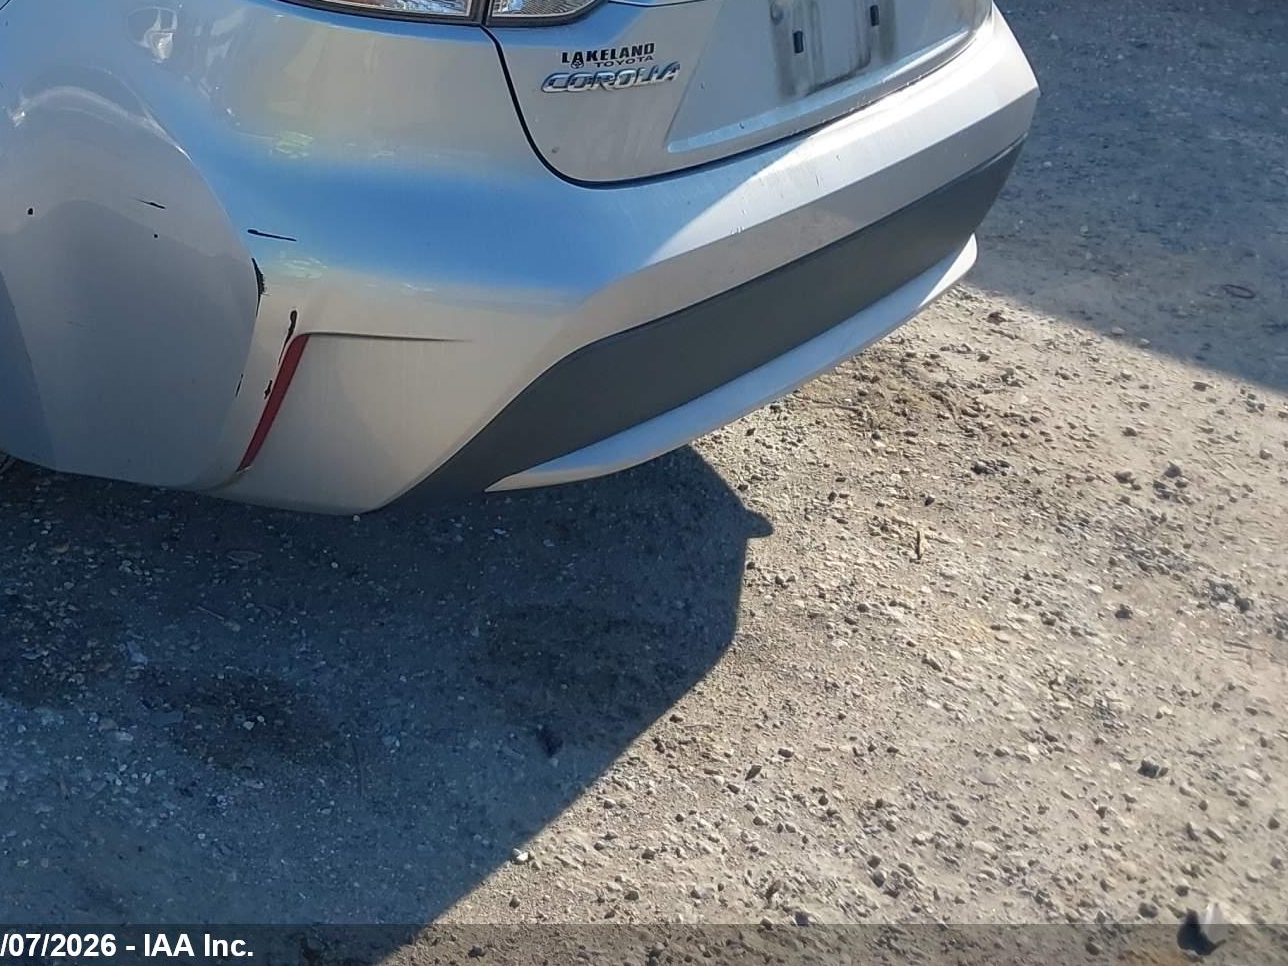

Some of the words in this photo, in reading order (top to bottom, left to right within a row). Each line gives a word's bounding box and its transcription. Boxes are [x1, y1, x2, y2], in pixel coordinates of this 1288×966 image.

[561, 43, 655, 68] LAKELAND
[594, 55, 654, 68] TOYOTA
[541, 61, 681, 93] COROLLA
